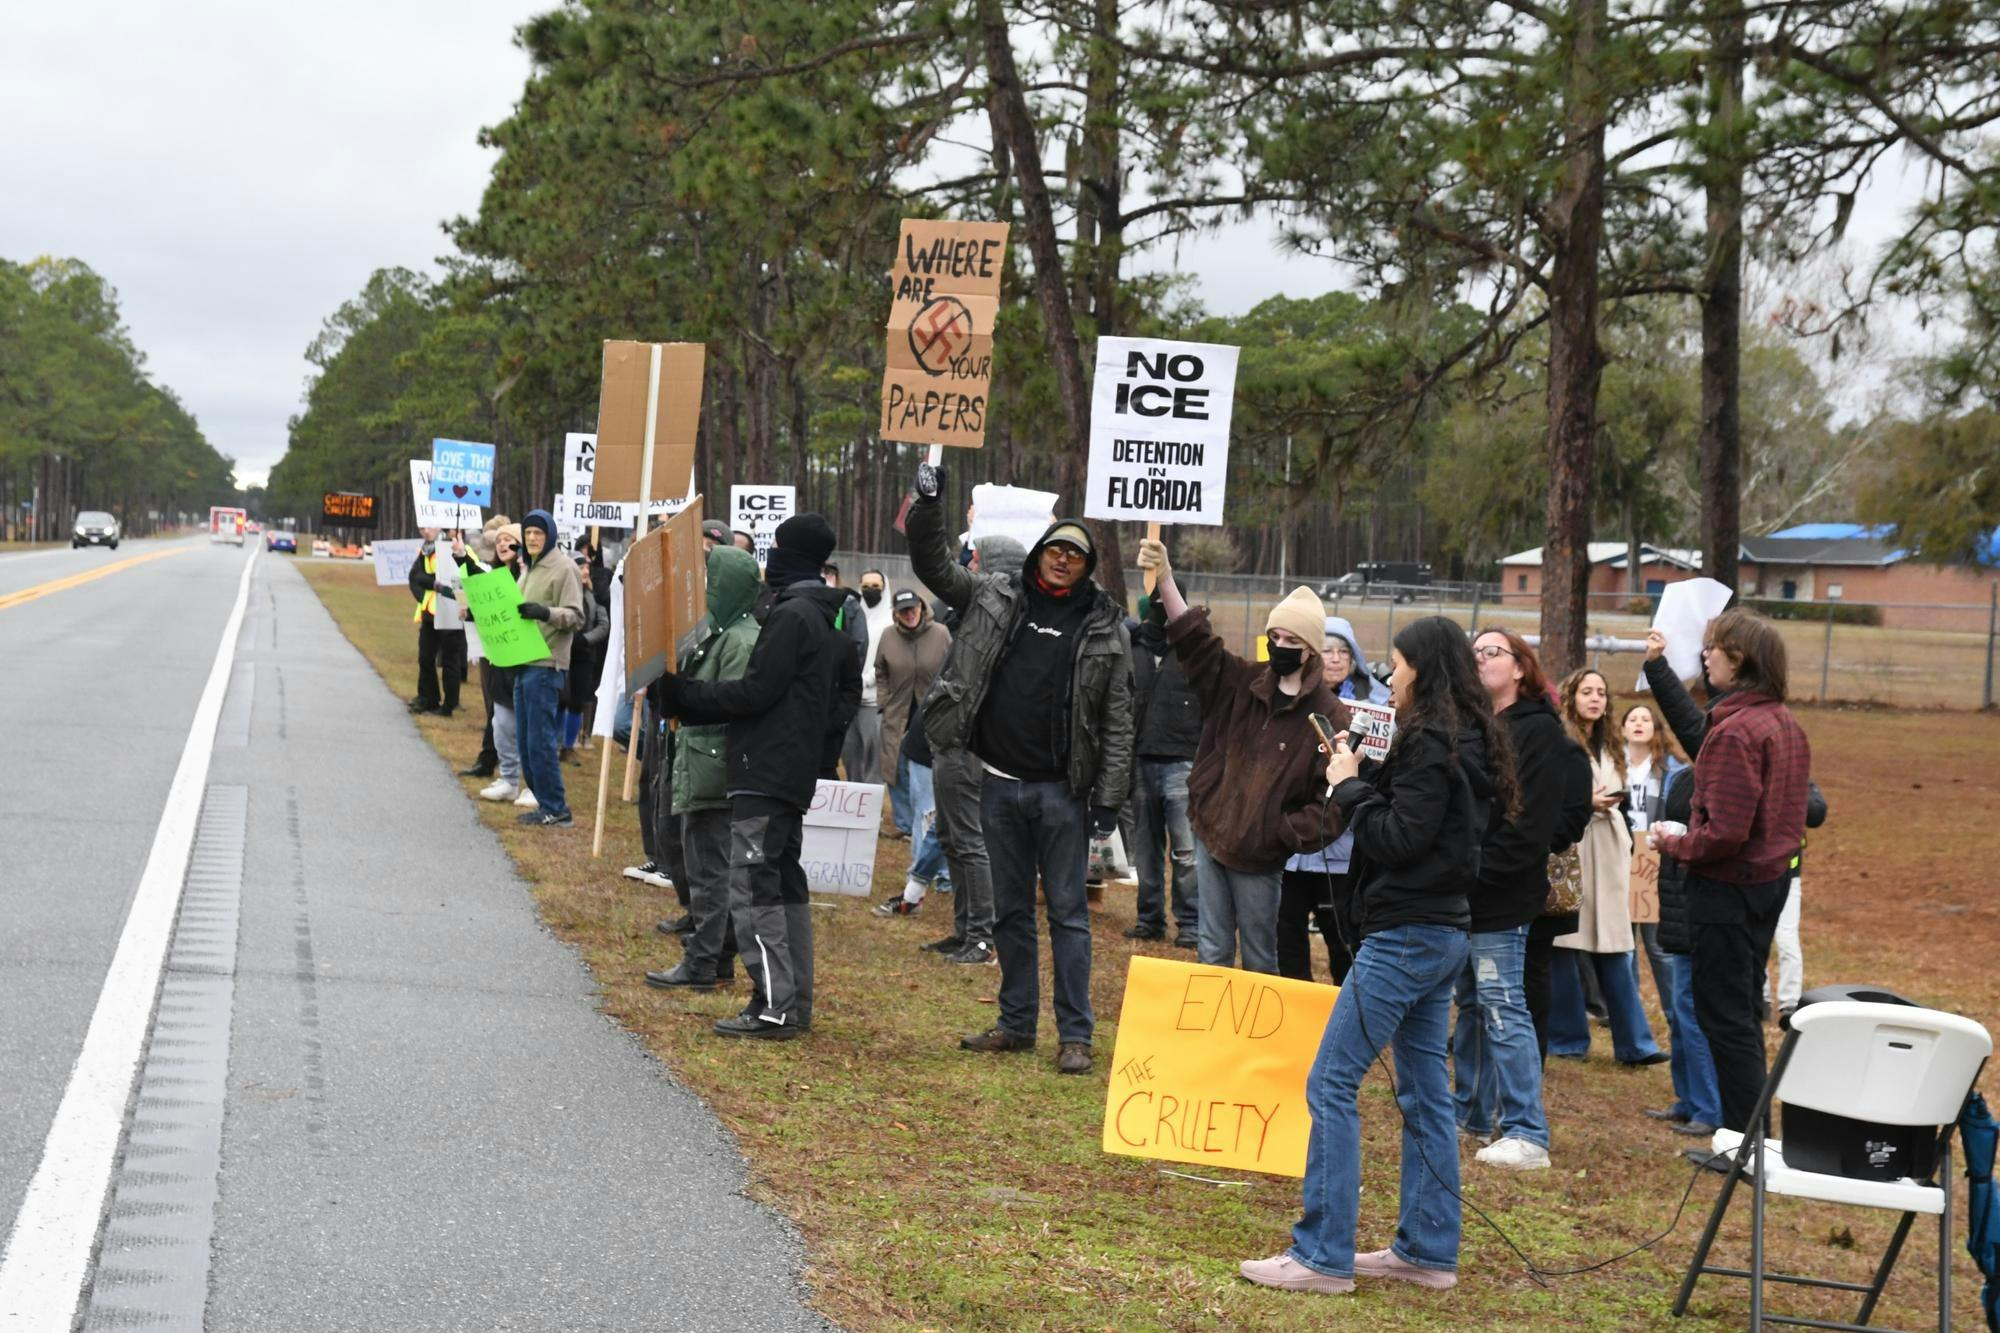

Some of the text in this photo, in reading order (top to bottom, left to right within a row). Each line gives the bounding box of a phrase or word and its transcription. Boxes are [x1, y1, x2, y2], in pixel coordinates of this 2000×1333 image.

[905, 232, 1001, 279] WHERE
[896, 275, 936, 303] ARE
[948, 354, 990, 382] YOUR
[1125, 351, 1205, 382] NO
[887, 383, 985, 433] PAPERS
[1114, 383, 1210, 421] ICE
[433, 449, 493, 470] LOVE THY
[581, 441, 596, 454] N
[1112, 439, 1204, 467] DETENTION
[432, 466, 490, 487] NEIGHBOR
[576, 456, 594, 472] IC
[1147, 467, 1167, 477] IN
[738, 494, 787, 511] ICE
[1107, 476, 1202, 513] FLORIDA
[444, 506, 477, 520] stpo
[574, 503, 622, 521] FLORIDA
[738, 512, 785, 521] OUT OF
[809, 784, 873, 818] STICE
[1175, 973, 1285, 1040] END
[1117, 1054, 1156, 1087] THE
